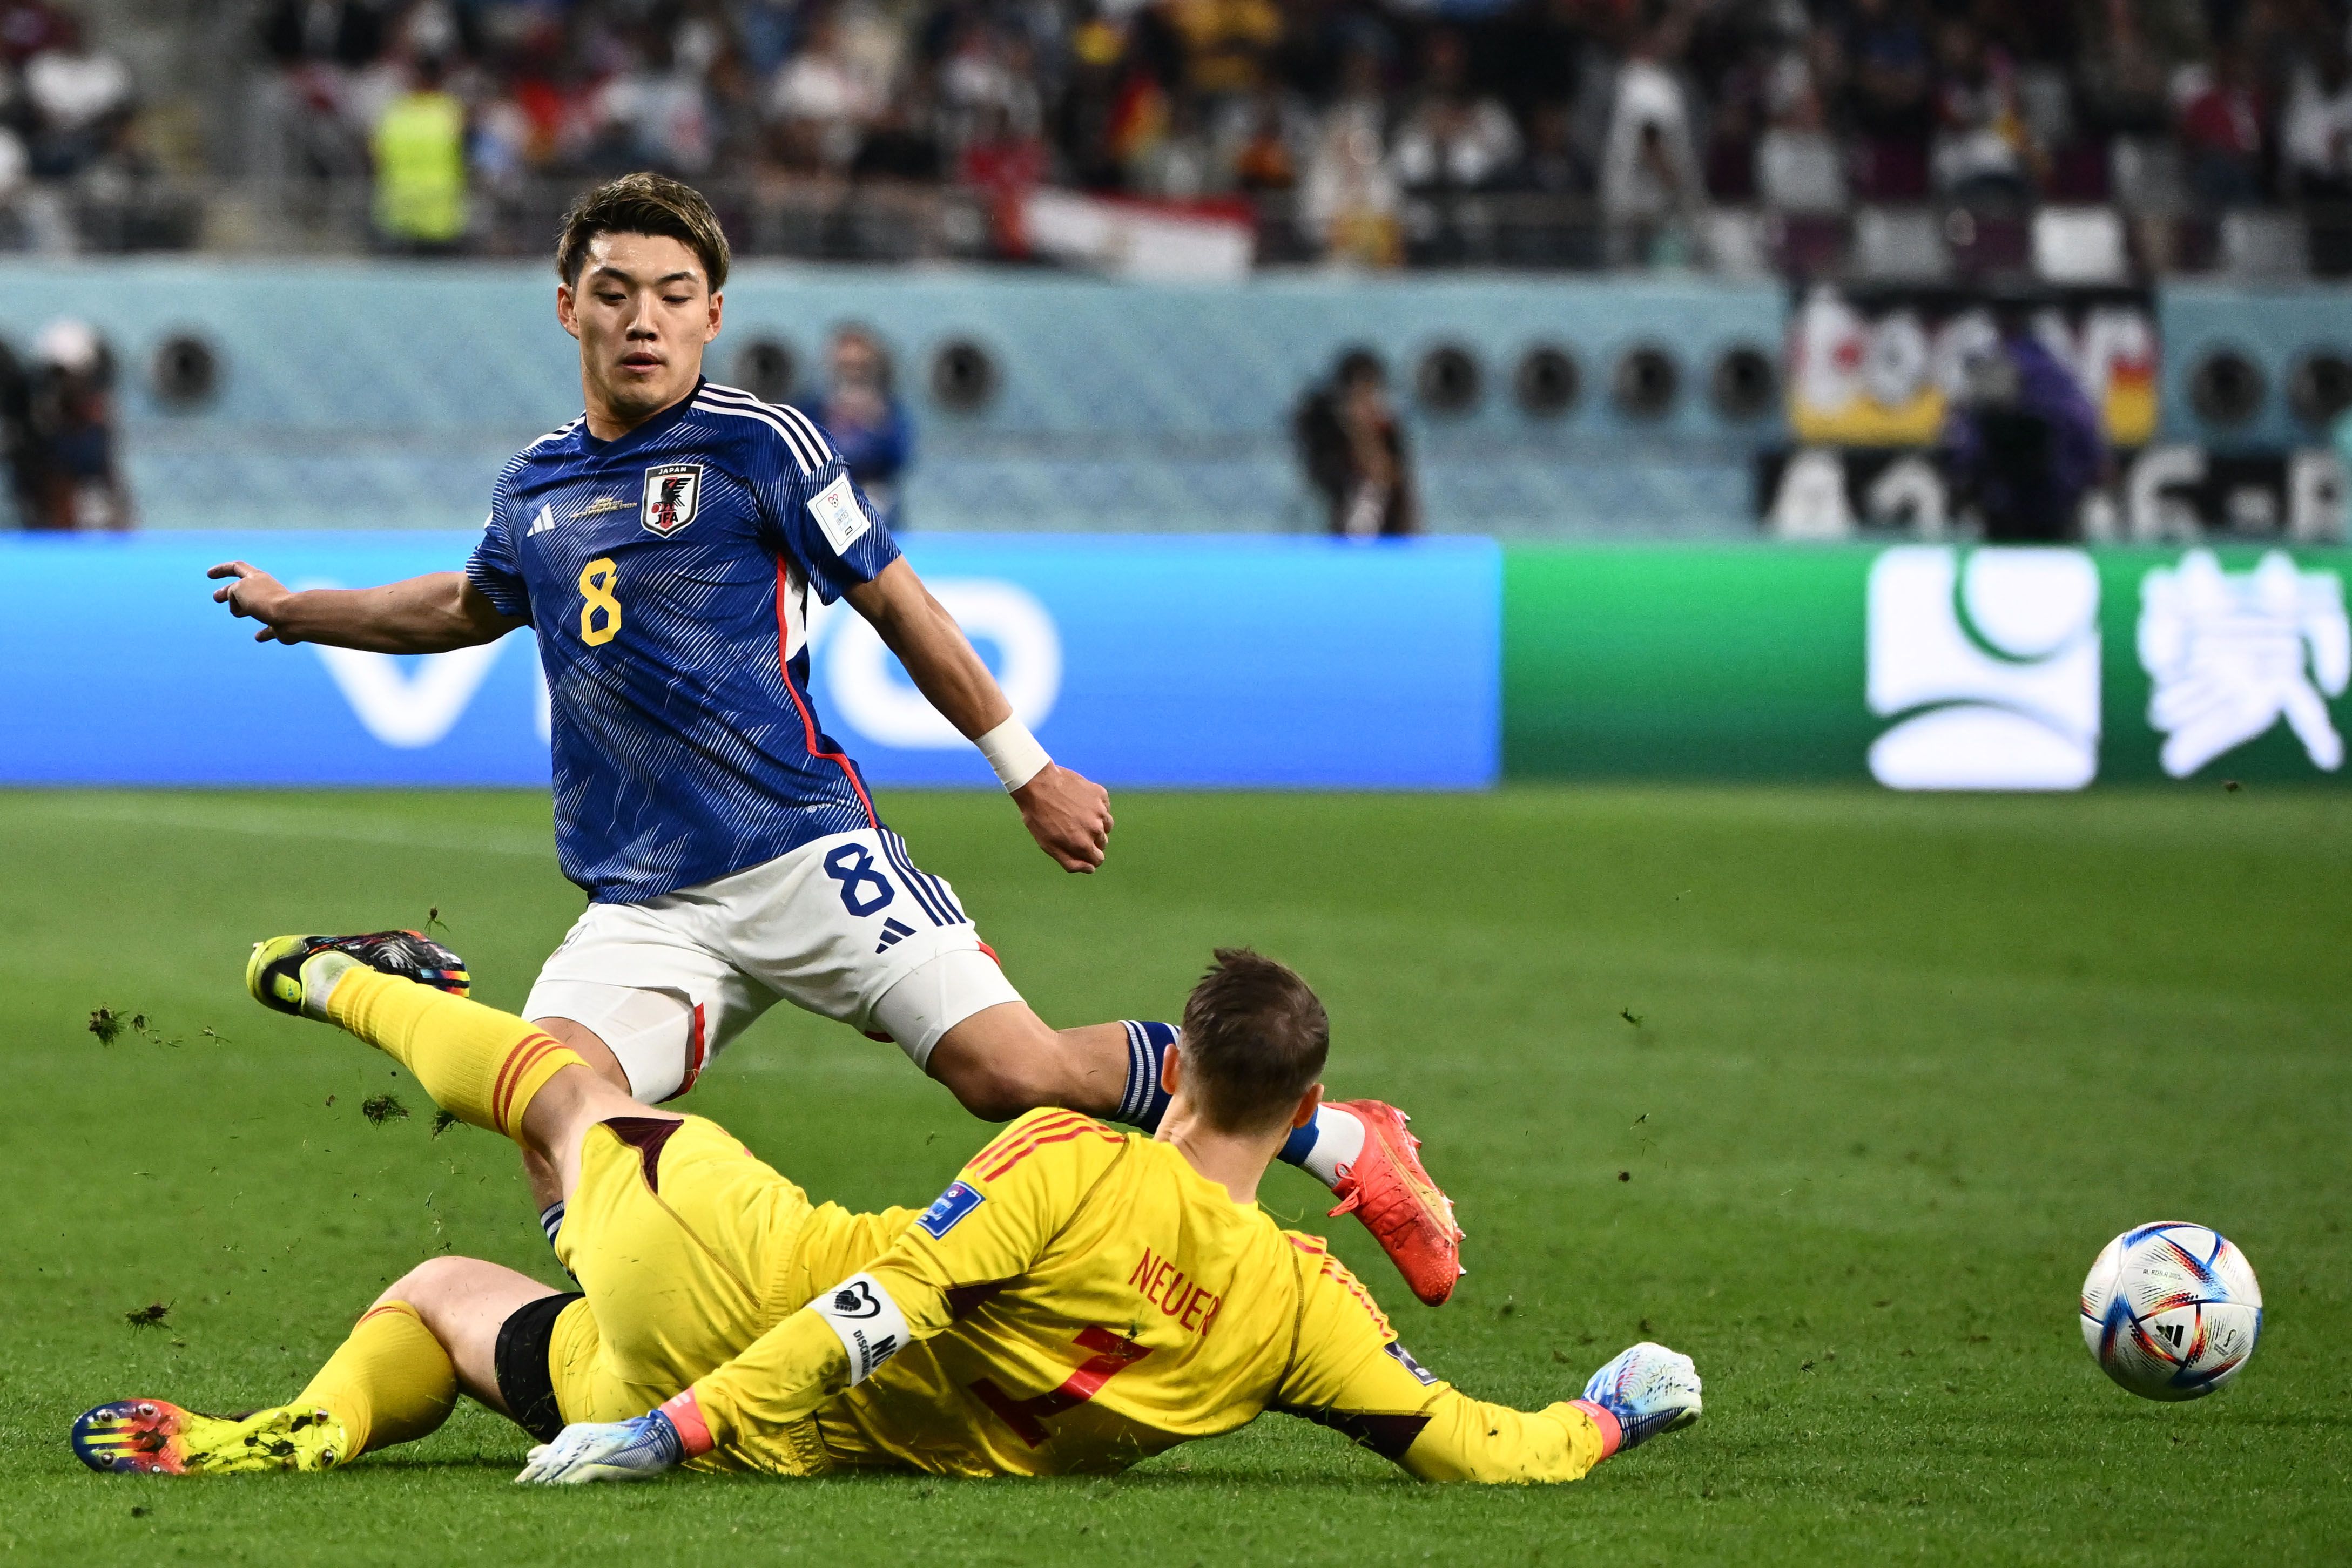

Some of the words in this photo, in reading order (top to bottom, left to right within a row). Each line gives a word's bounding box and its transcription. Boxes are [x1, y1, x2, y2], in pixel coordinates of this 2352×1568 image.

[658, 467, 687, 475] JAPAN
[655, 512, 679, 524] JFA
[579, 557, 622, 647] 8
[823, 843, 895, 917] 8
[1128, 1247, 1220, 1337] NEUER
[871, 1334, 897, 1368] NO
